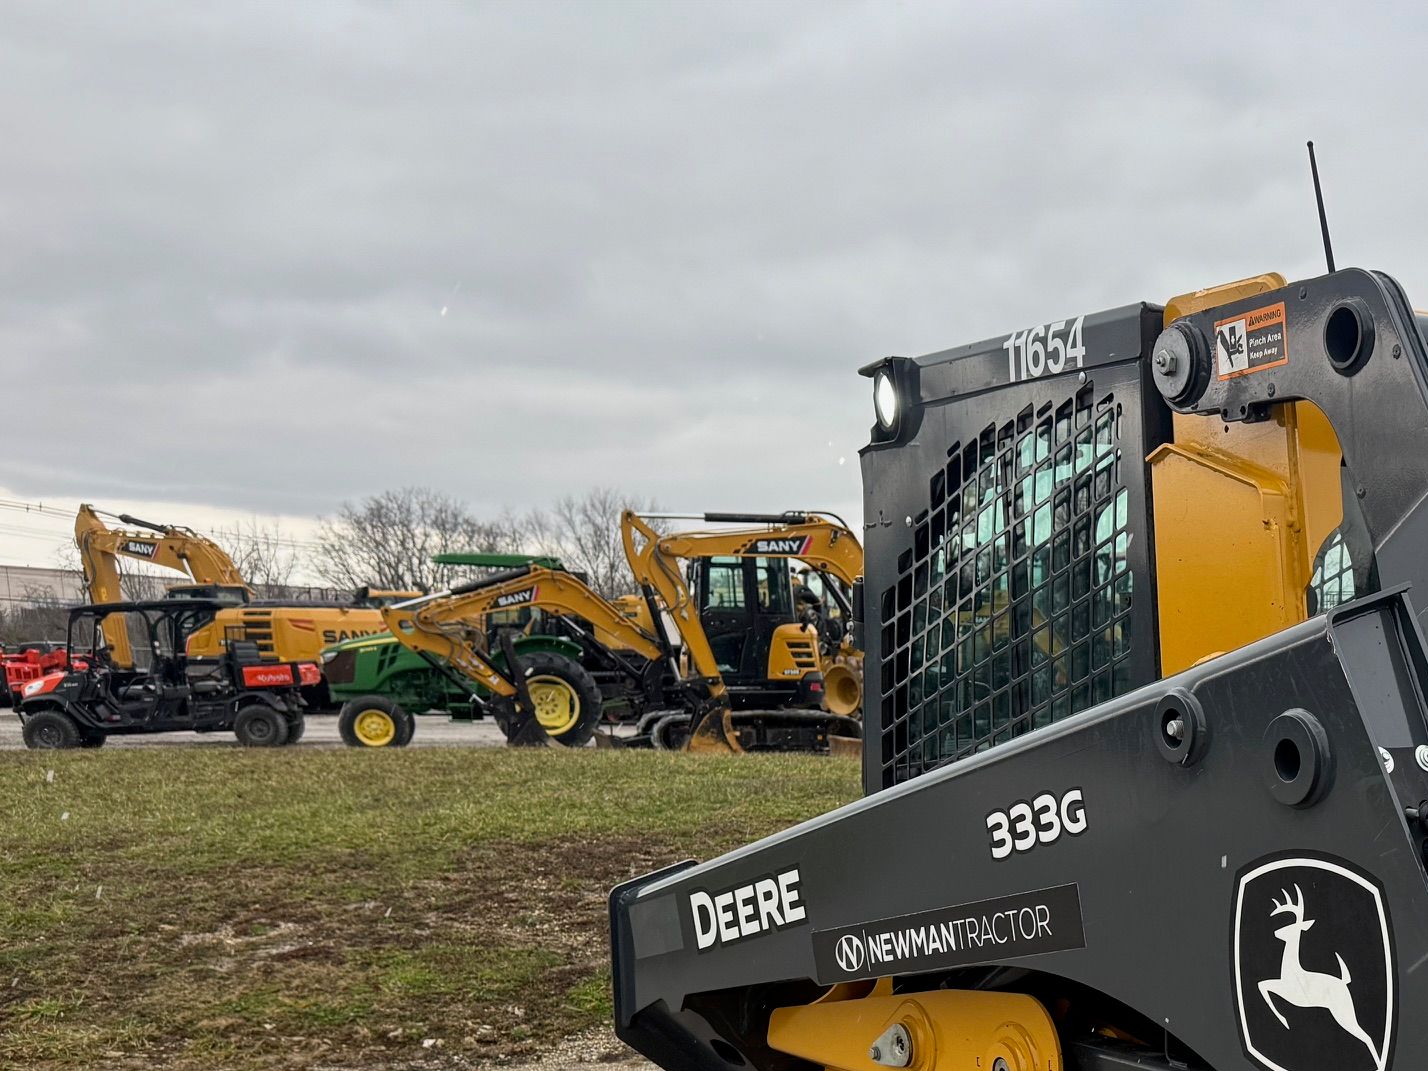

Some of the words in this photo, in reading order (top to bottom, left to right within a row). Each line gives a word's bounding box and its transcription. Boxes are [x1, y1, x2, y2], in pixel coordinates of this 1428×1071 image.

[1253, 309, 1281, 324] WARNING
[1249, 336, 1266, 347] Pinch
[1267, 332, 1282, 343] Area
[1002, 315, 1086, 383] 11654
[1249, 351, 1263, 360] Keep
[1264, 347, 1278, 356] Away
[128, 541, 154, 555] SANY
[756, 540, 800, 552] SANY
[497, 590, 531, 606] SANY
[985, 789, 1089, 860] 333G
[689, 868, 807, 950] DEERE
